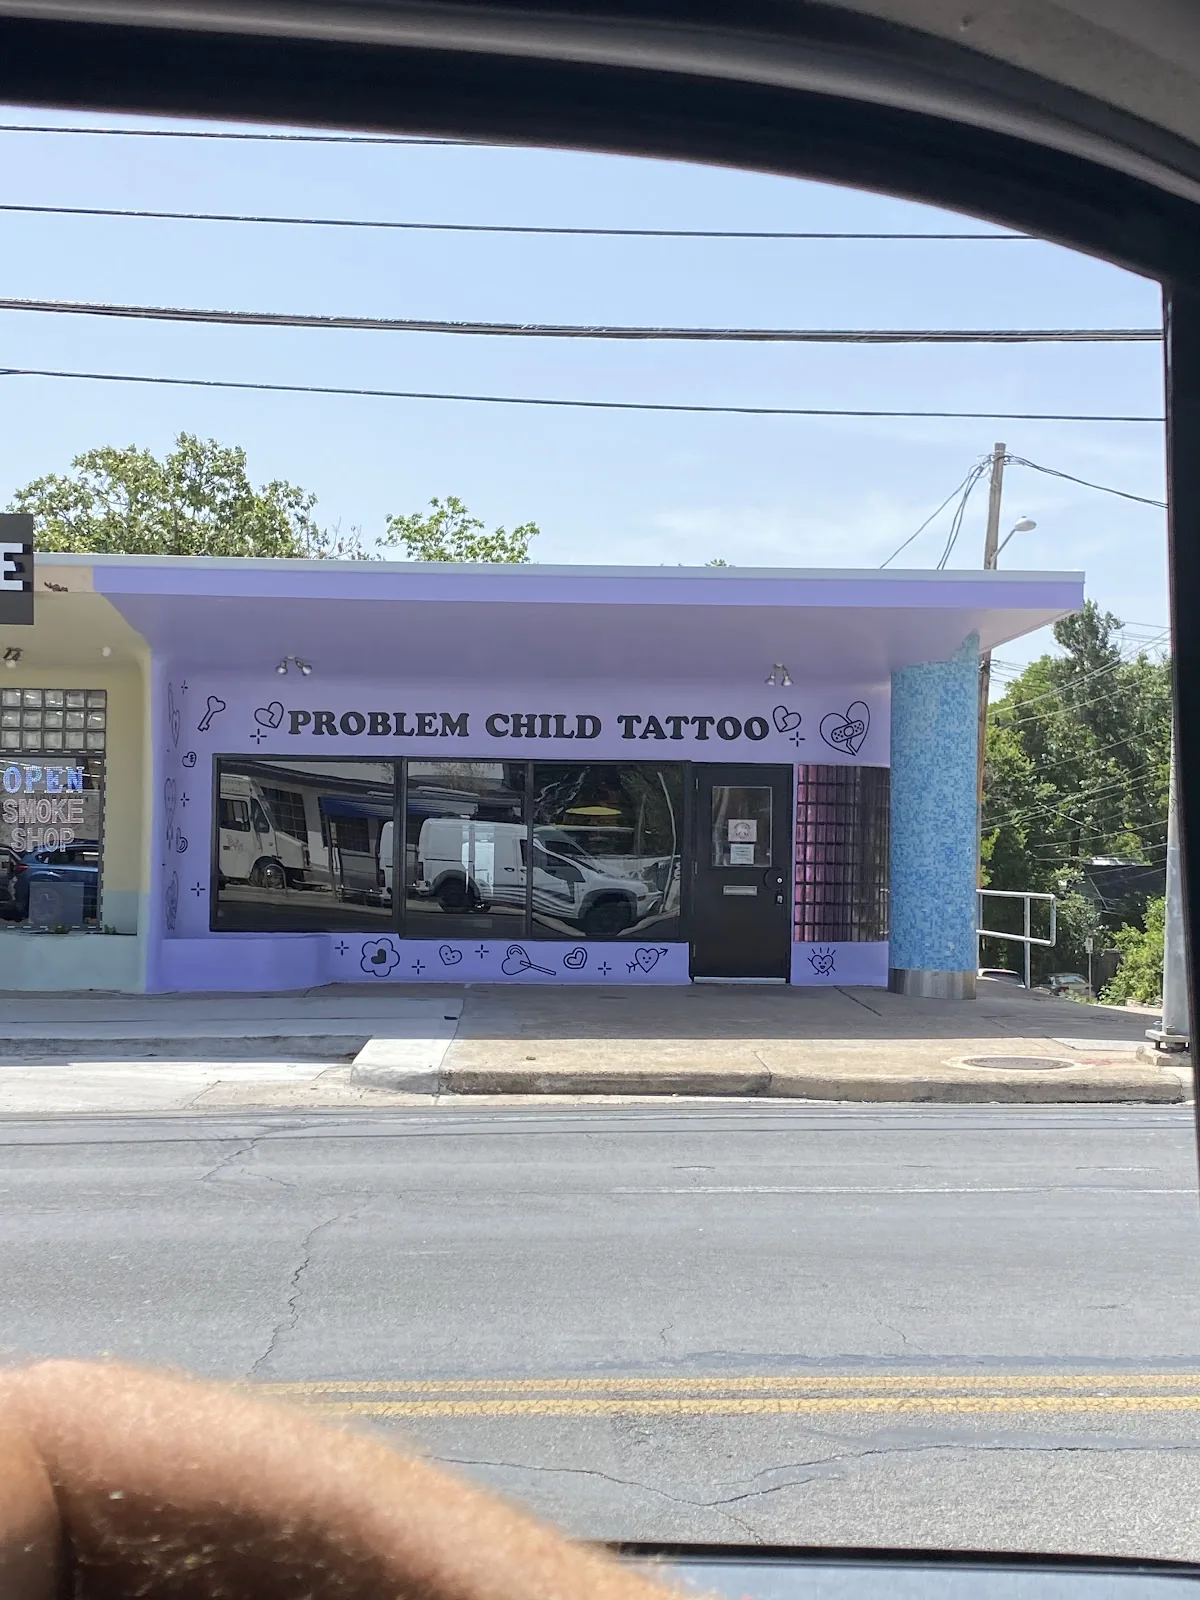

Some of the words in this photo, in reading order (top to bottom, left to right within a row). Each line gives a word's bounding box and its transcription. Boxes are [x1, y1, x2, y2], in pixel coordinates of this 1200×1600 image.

[0, 543, 23, 591] E
[287, 710, 470, 738] PROBLEM
[485, 713, 602, 740] CHILD
[616, 714, 770, 741] TATTOO
[3, 765, 85, 794] OPEN
[2, 798, 84, 824] SMOKE
[10, 827, 75, 853] SHOP
